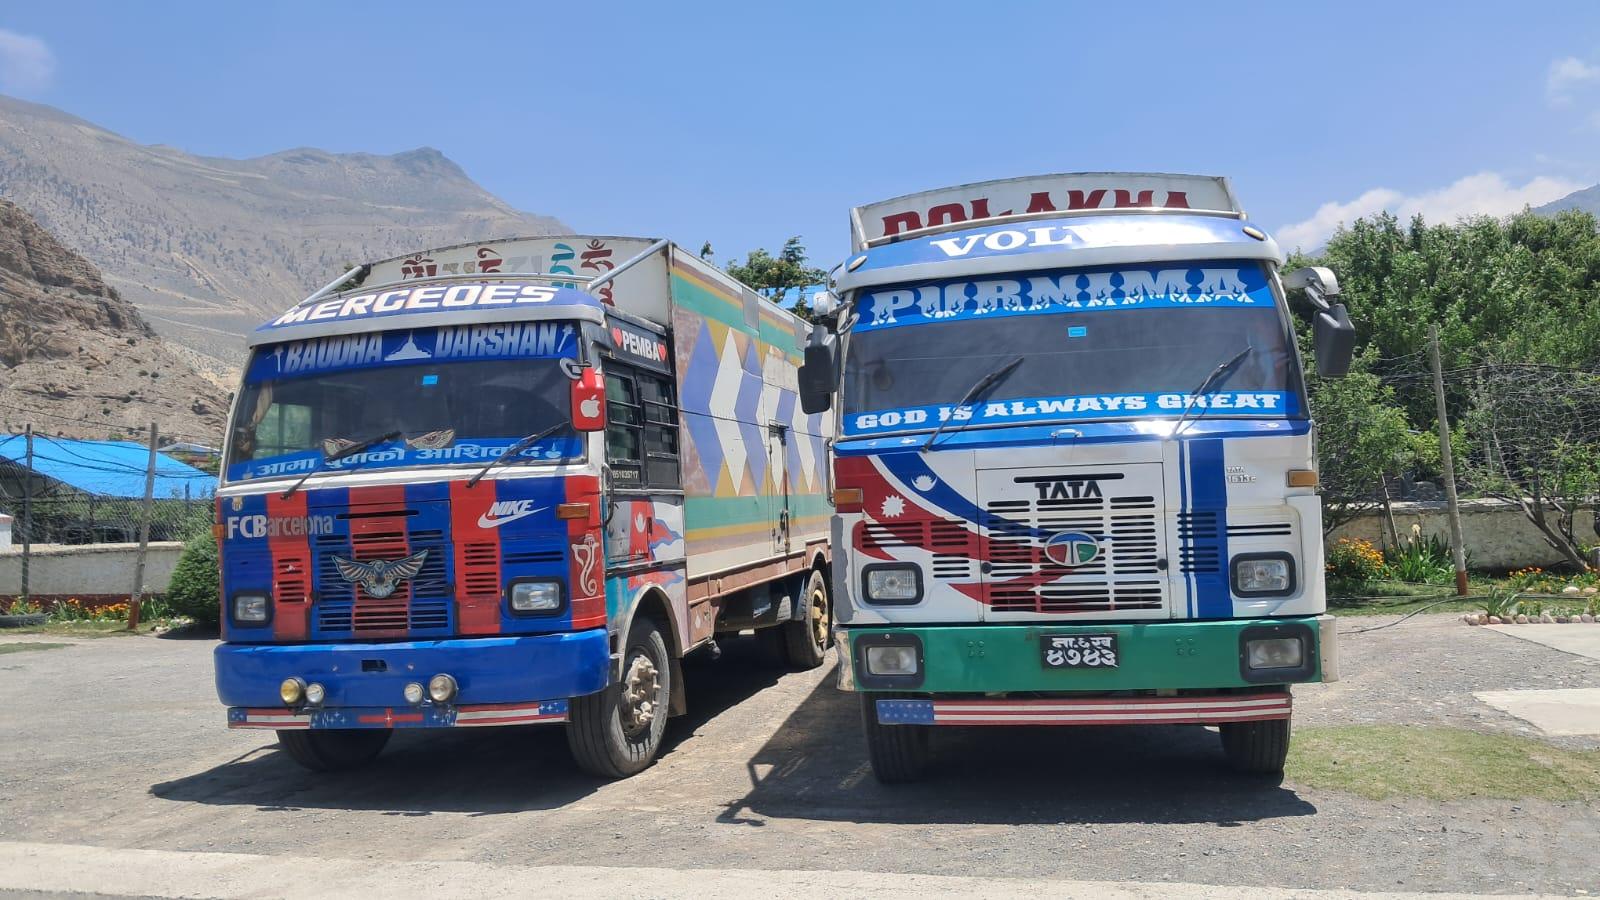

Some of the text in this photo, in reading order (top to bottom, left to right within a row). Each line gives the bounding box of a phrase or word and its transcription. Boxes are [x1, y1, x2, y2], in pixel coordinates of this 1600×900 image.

[870, 268, 1254, 326] PURNIMA
[284, 323, 558, 372] BAUDHA DARSHAN
[622, 330, 661, 361] PEMBA
[856, 393, 1280, 429] GOD IS ALWAYS GREAT
[256, 458, 317, 476] आमा
[416, 443, 544, 459] आशिर्वद
[1034, 480, 1103, 499] TATA
[487, 499, 534, 516] NIKE
[227, 514, 333, 539] FCBarcelona
